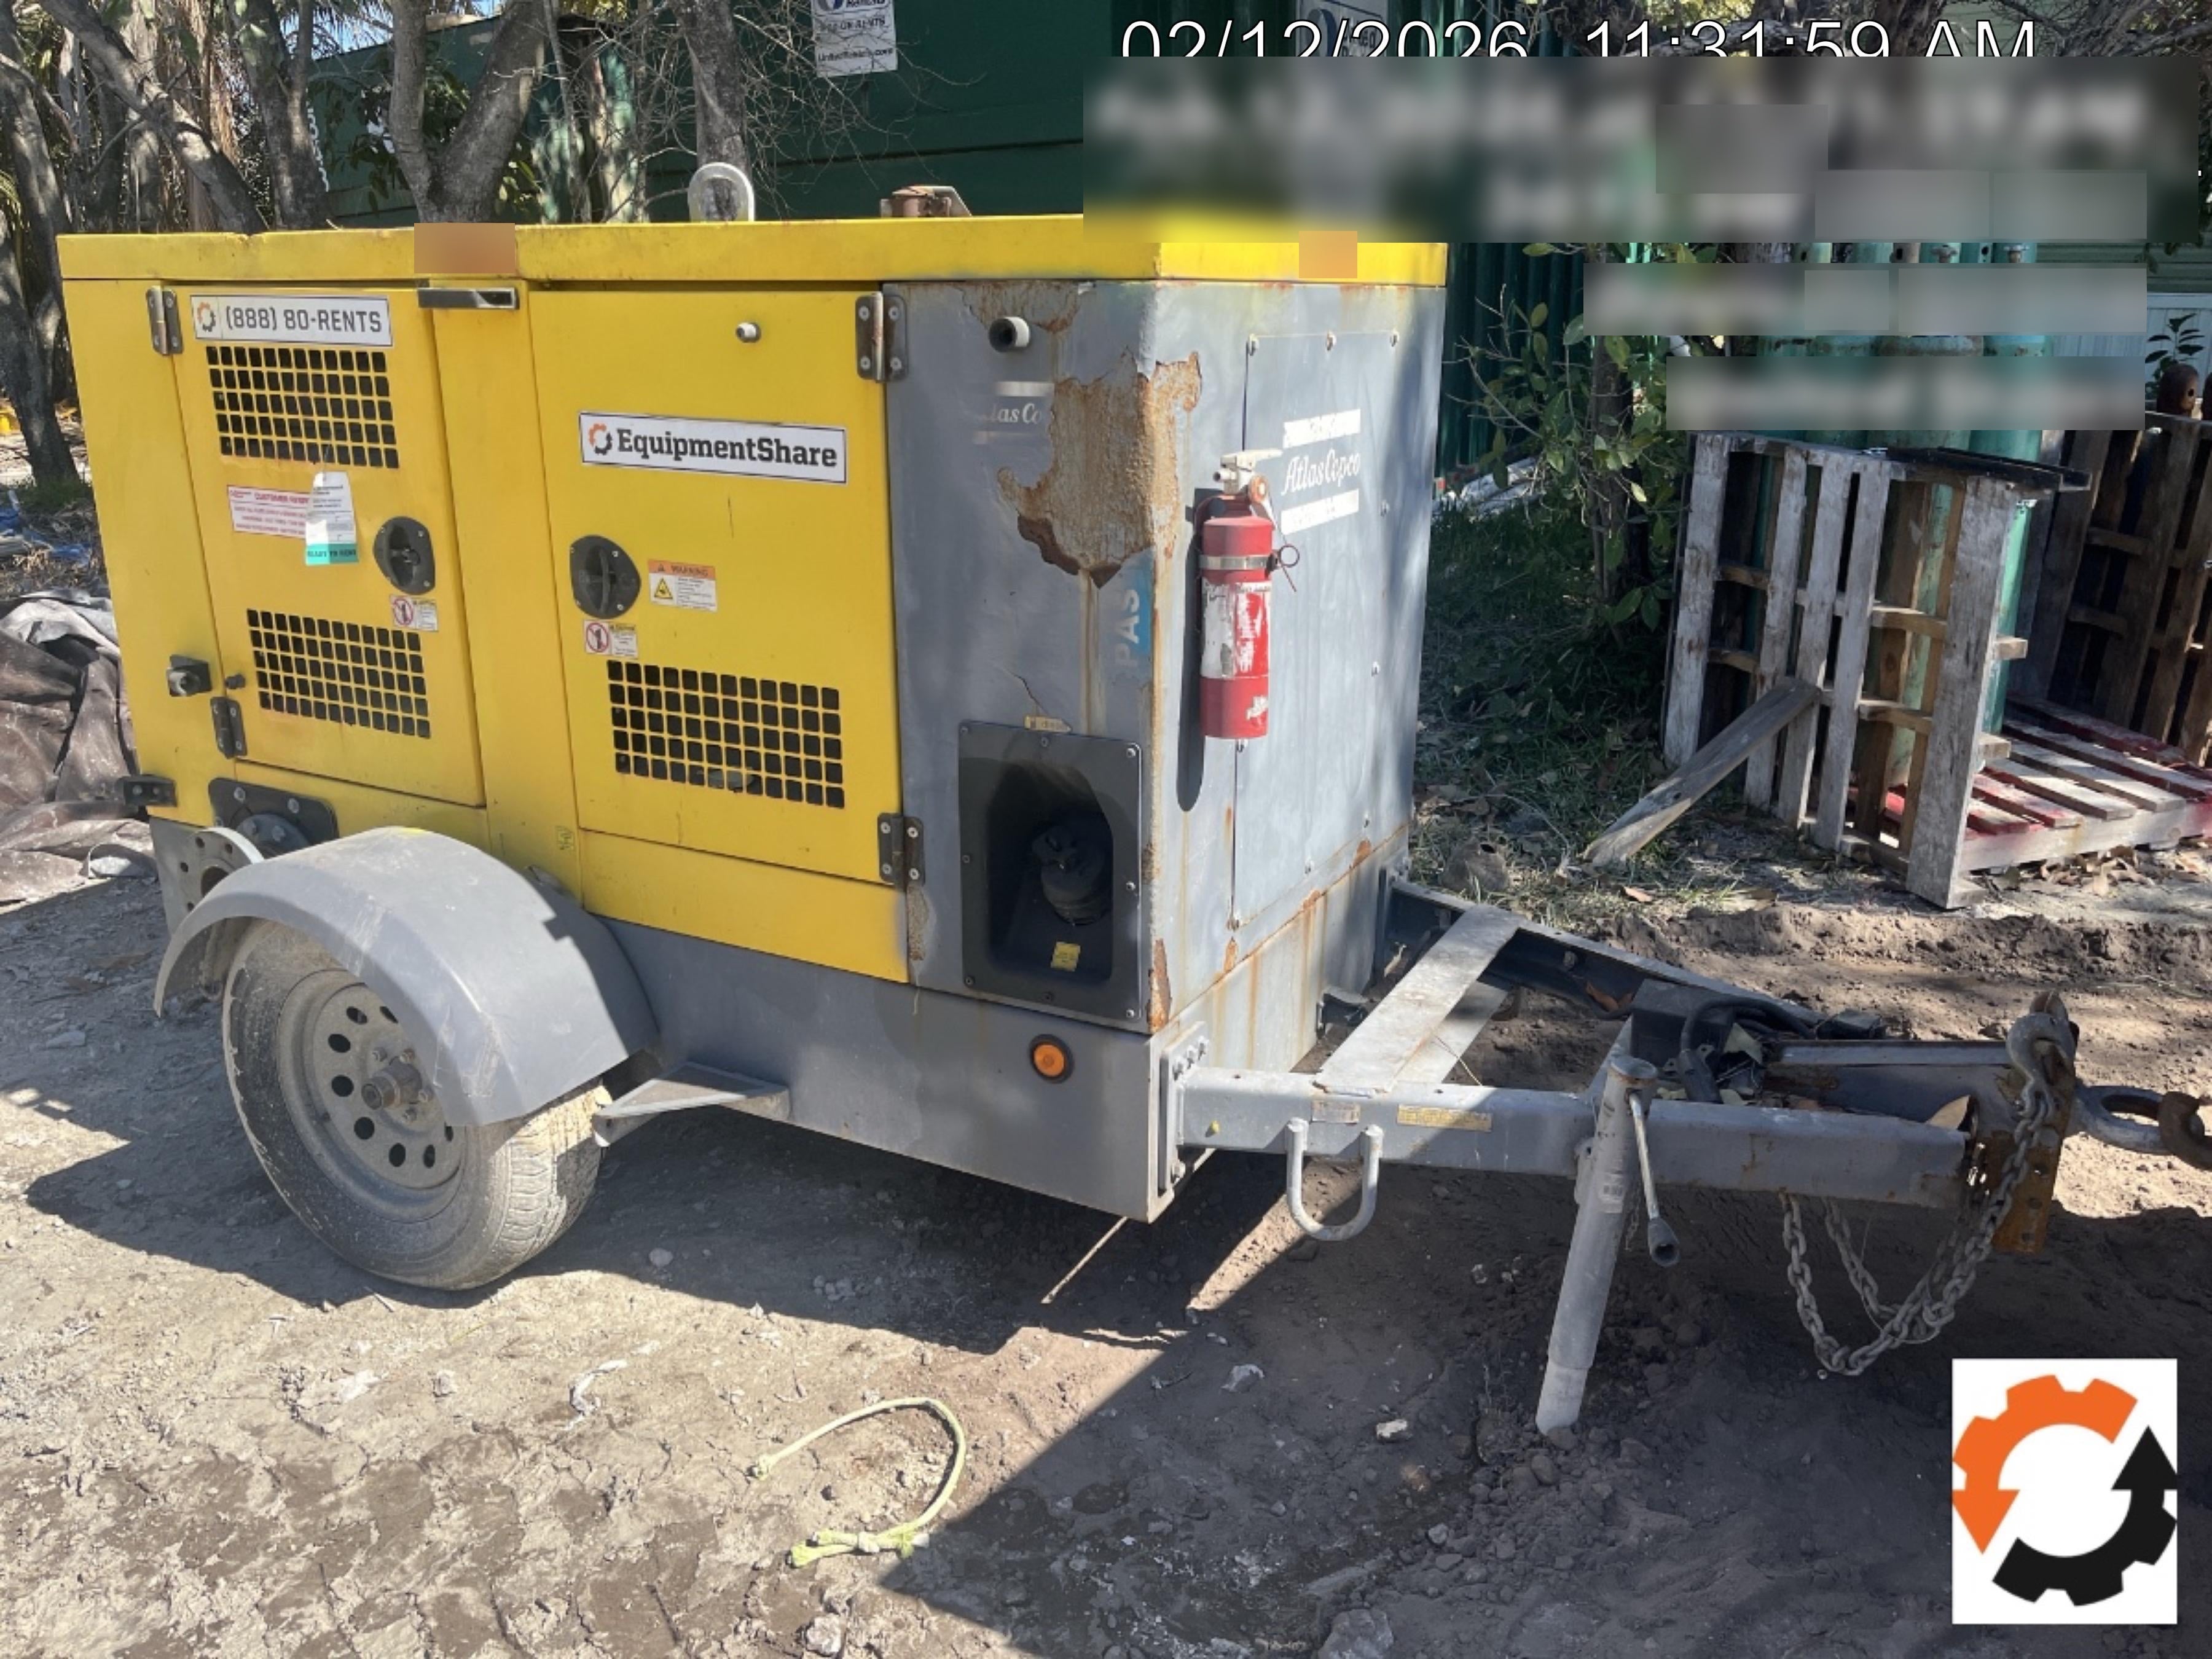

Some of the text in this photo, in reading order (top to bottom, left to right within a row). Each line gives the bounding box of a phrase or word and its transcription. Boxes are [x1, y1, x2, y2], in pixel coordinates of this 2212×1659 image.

[226, 306, 383, 333] (888) 80-RENTS
[616, 428, 837, 467] EquipmentShare
[1281, 448, 1362, 496] Atlas Copco
[1115, 589, 1140, 669] PAS
